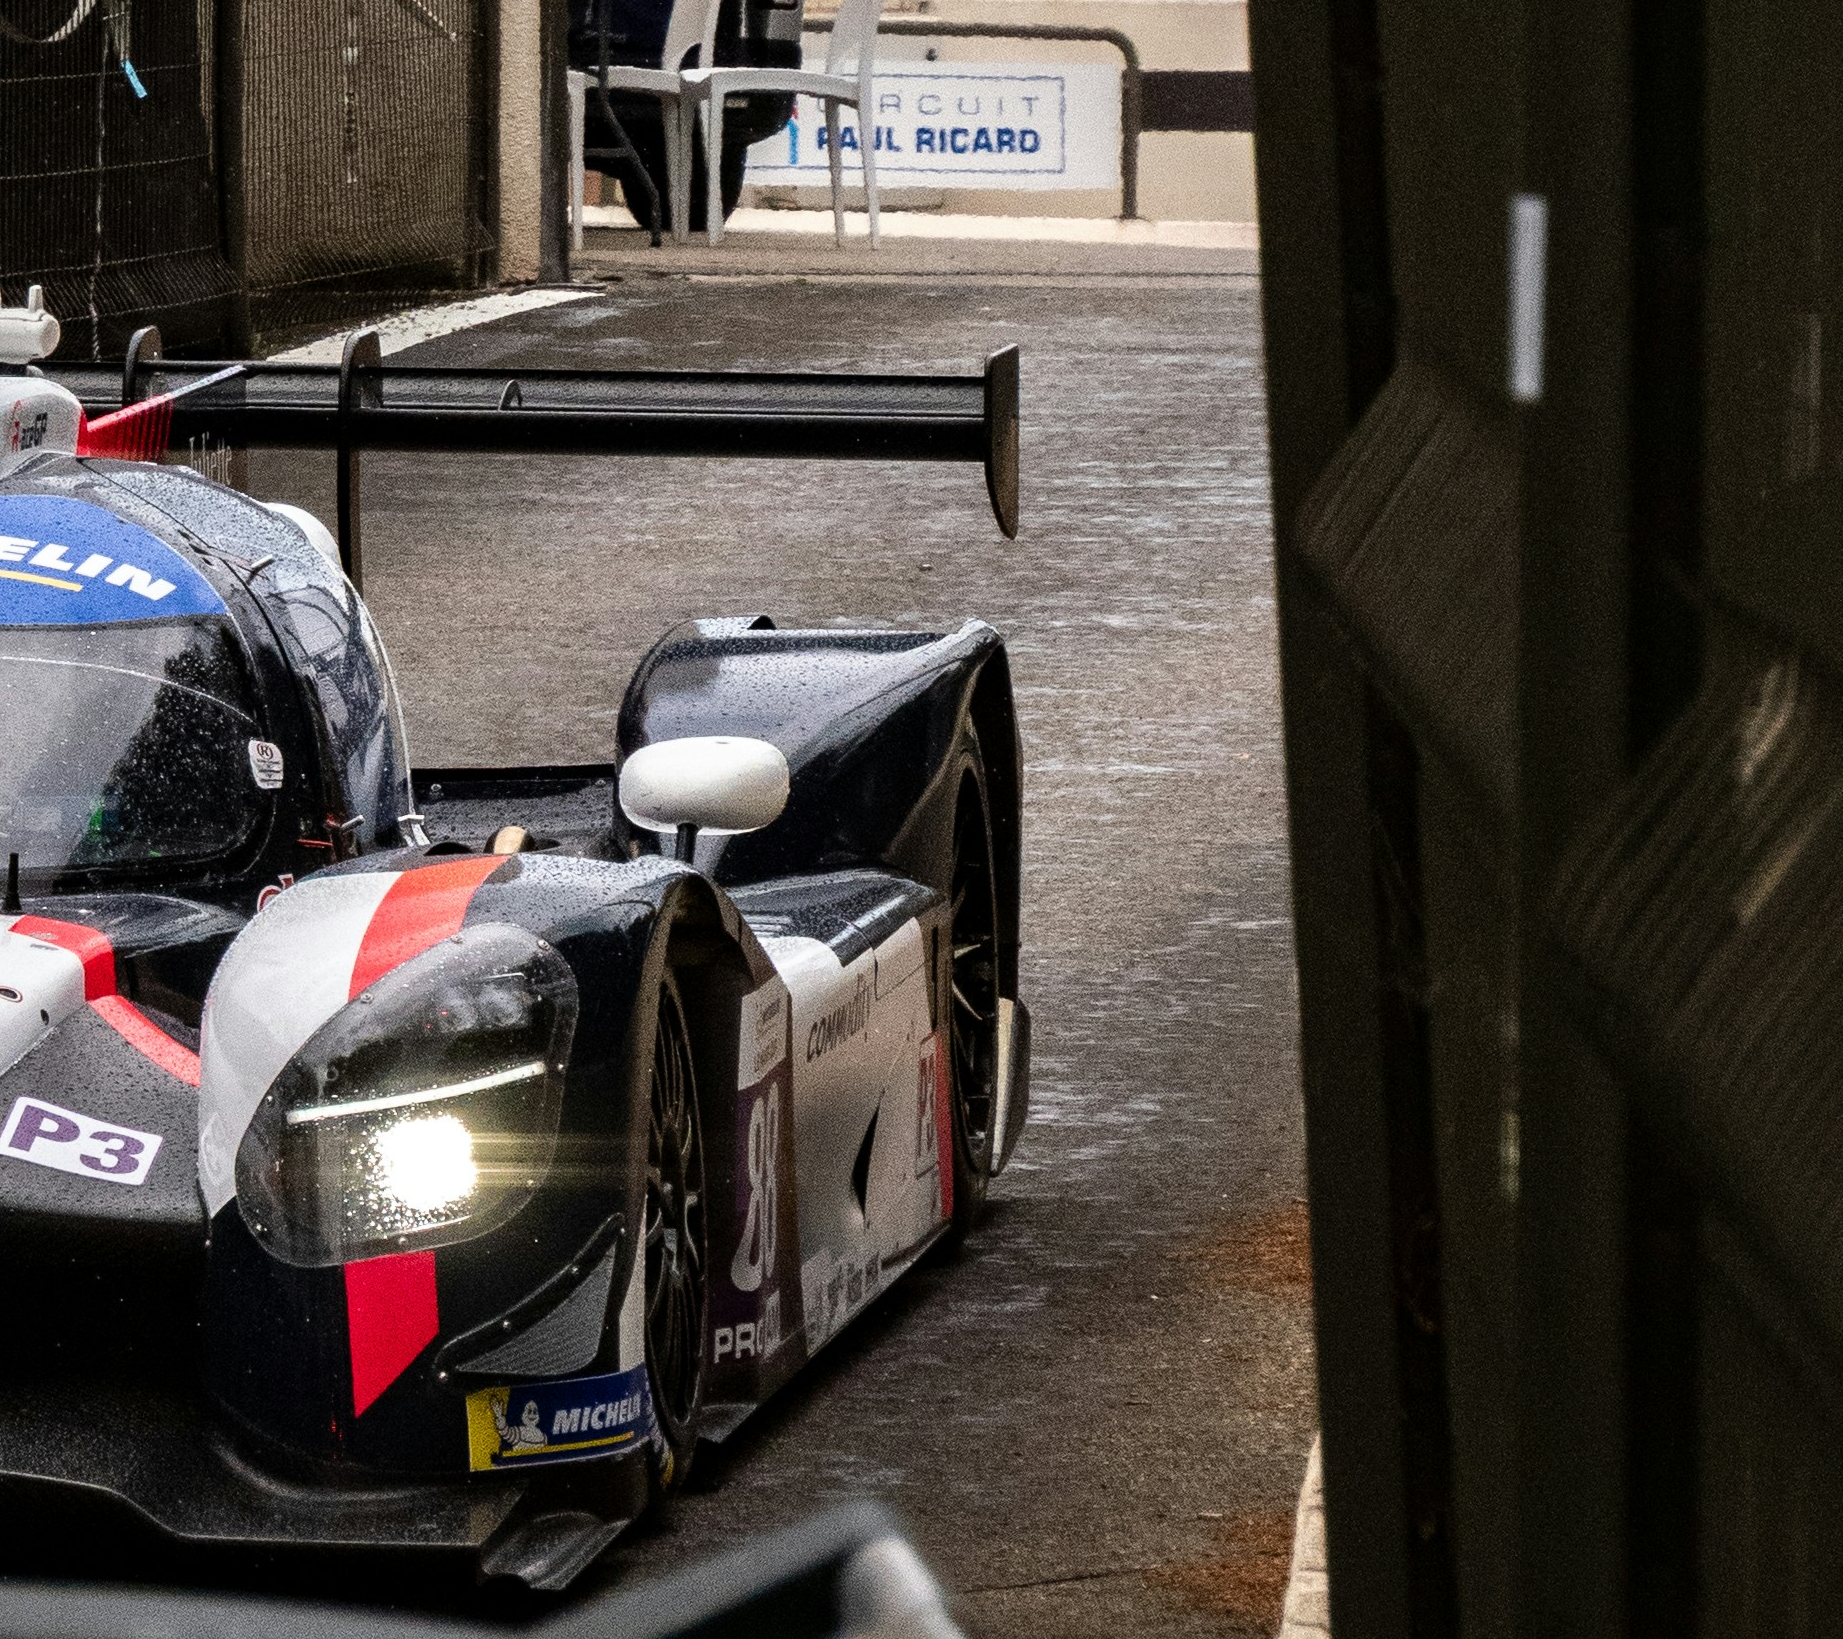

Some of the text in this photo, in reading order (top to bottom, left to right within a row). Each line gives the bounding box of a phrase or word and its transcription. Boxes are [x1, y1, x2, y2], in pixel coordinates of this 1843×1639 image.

[817, 93, 1040, 117] RCUIT
[915, 126, 1042, 155] RICARD
[8, 1104, 146, 1175] P3
